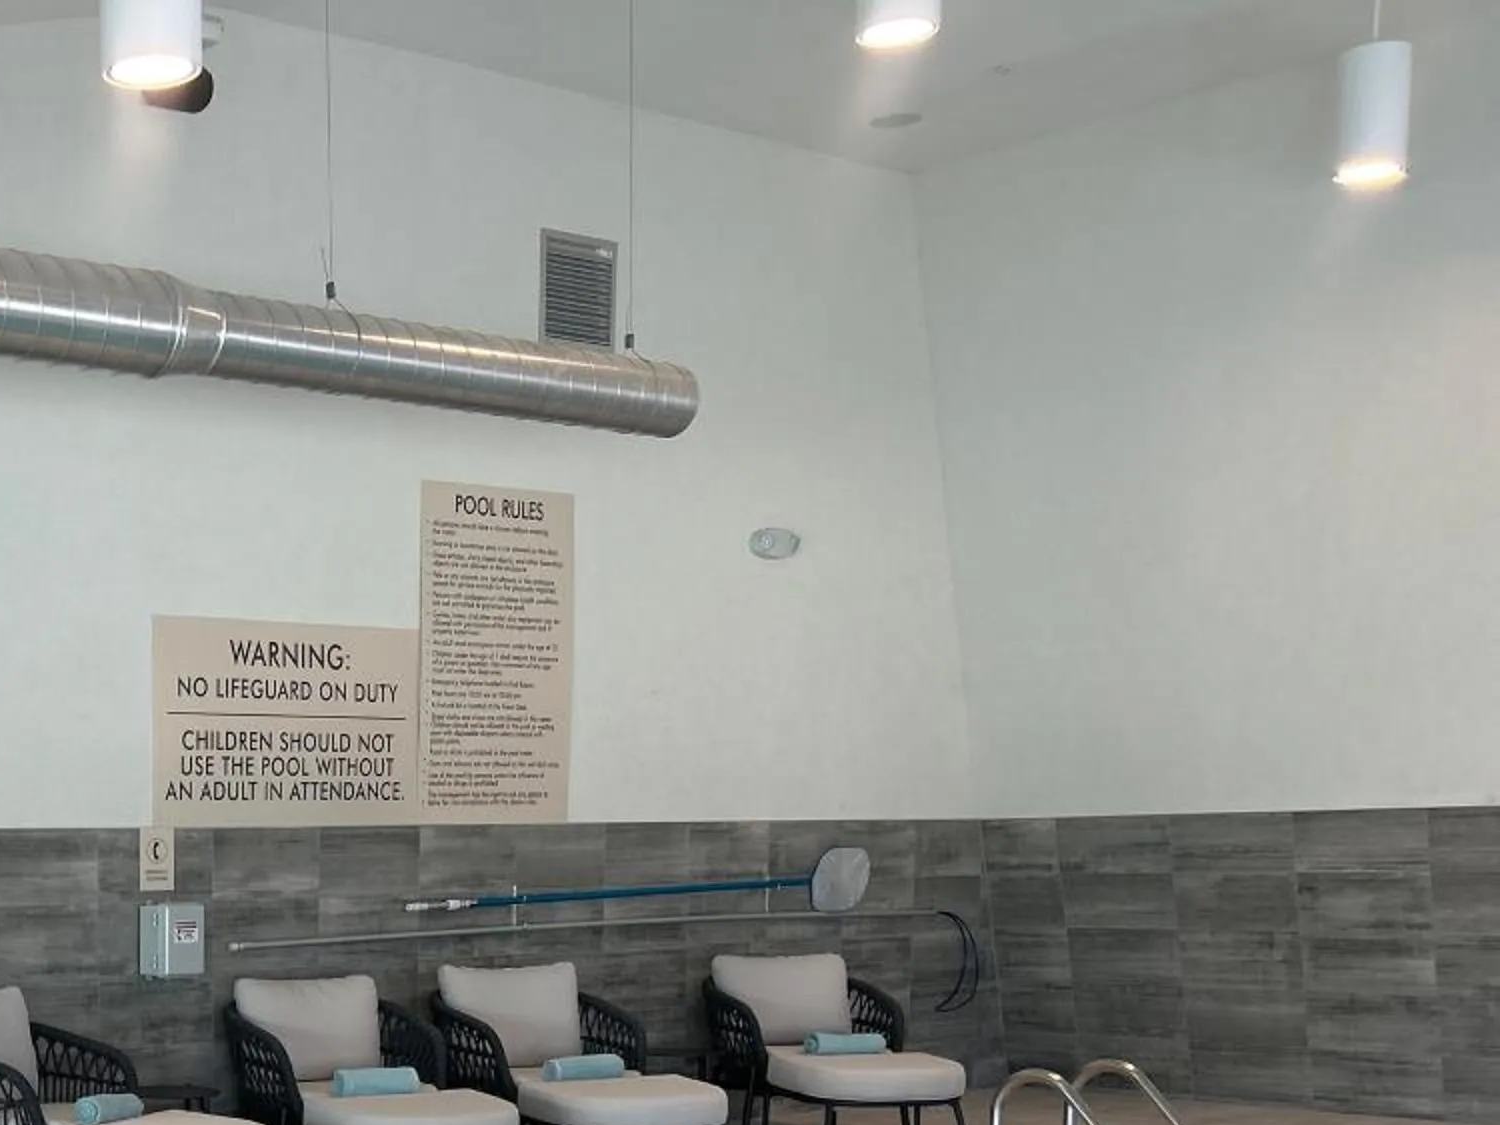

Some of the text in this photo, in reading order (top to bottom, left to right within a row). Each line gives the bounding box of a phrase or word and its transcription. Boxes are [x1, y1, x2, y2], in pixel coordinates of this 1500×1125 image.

[455, 495, 545, 521] POOL RULES
[229, 639, 351, 671] WARNING:
[177, 676, 399, 703] NO LIFEGUARD ON DUTY
[181, 730, 395, 753] CHILDREN SHOULD NOT
[181, 755, 395, 777] USE THE POOL WITHOUT
[165, 781, 193, 801] AN
[199, 781, 257, 801] ADULT
[264, 781, 283, 801] IN
[289, 781, 405, 801] ATTENDANCE.
